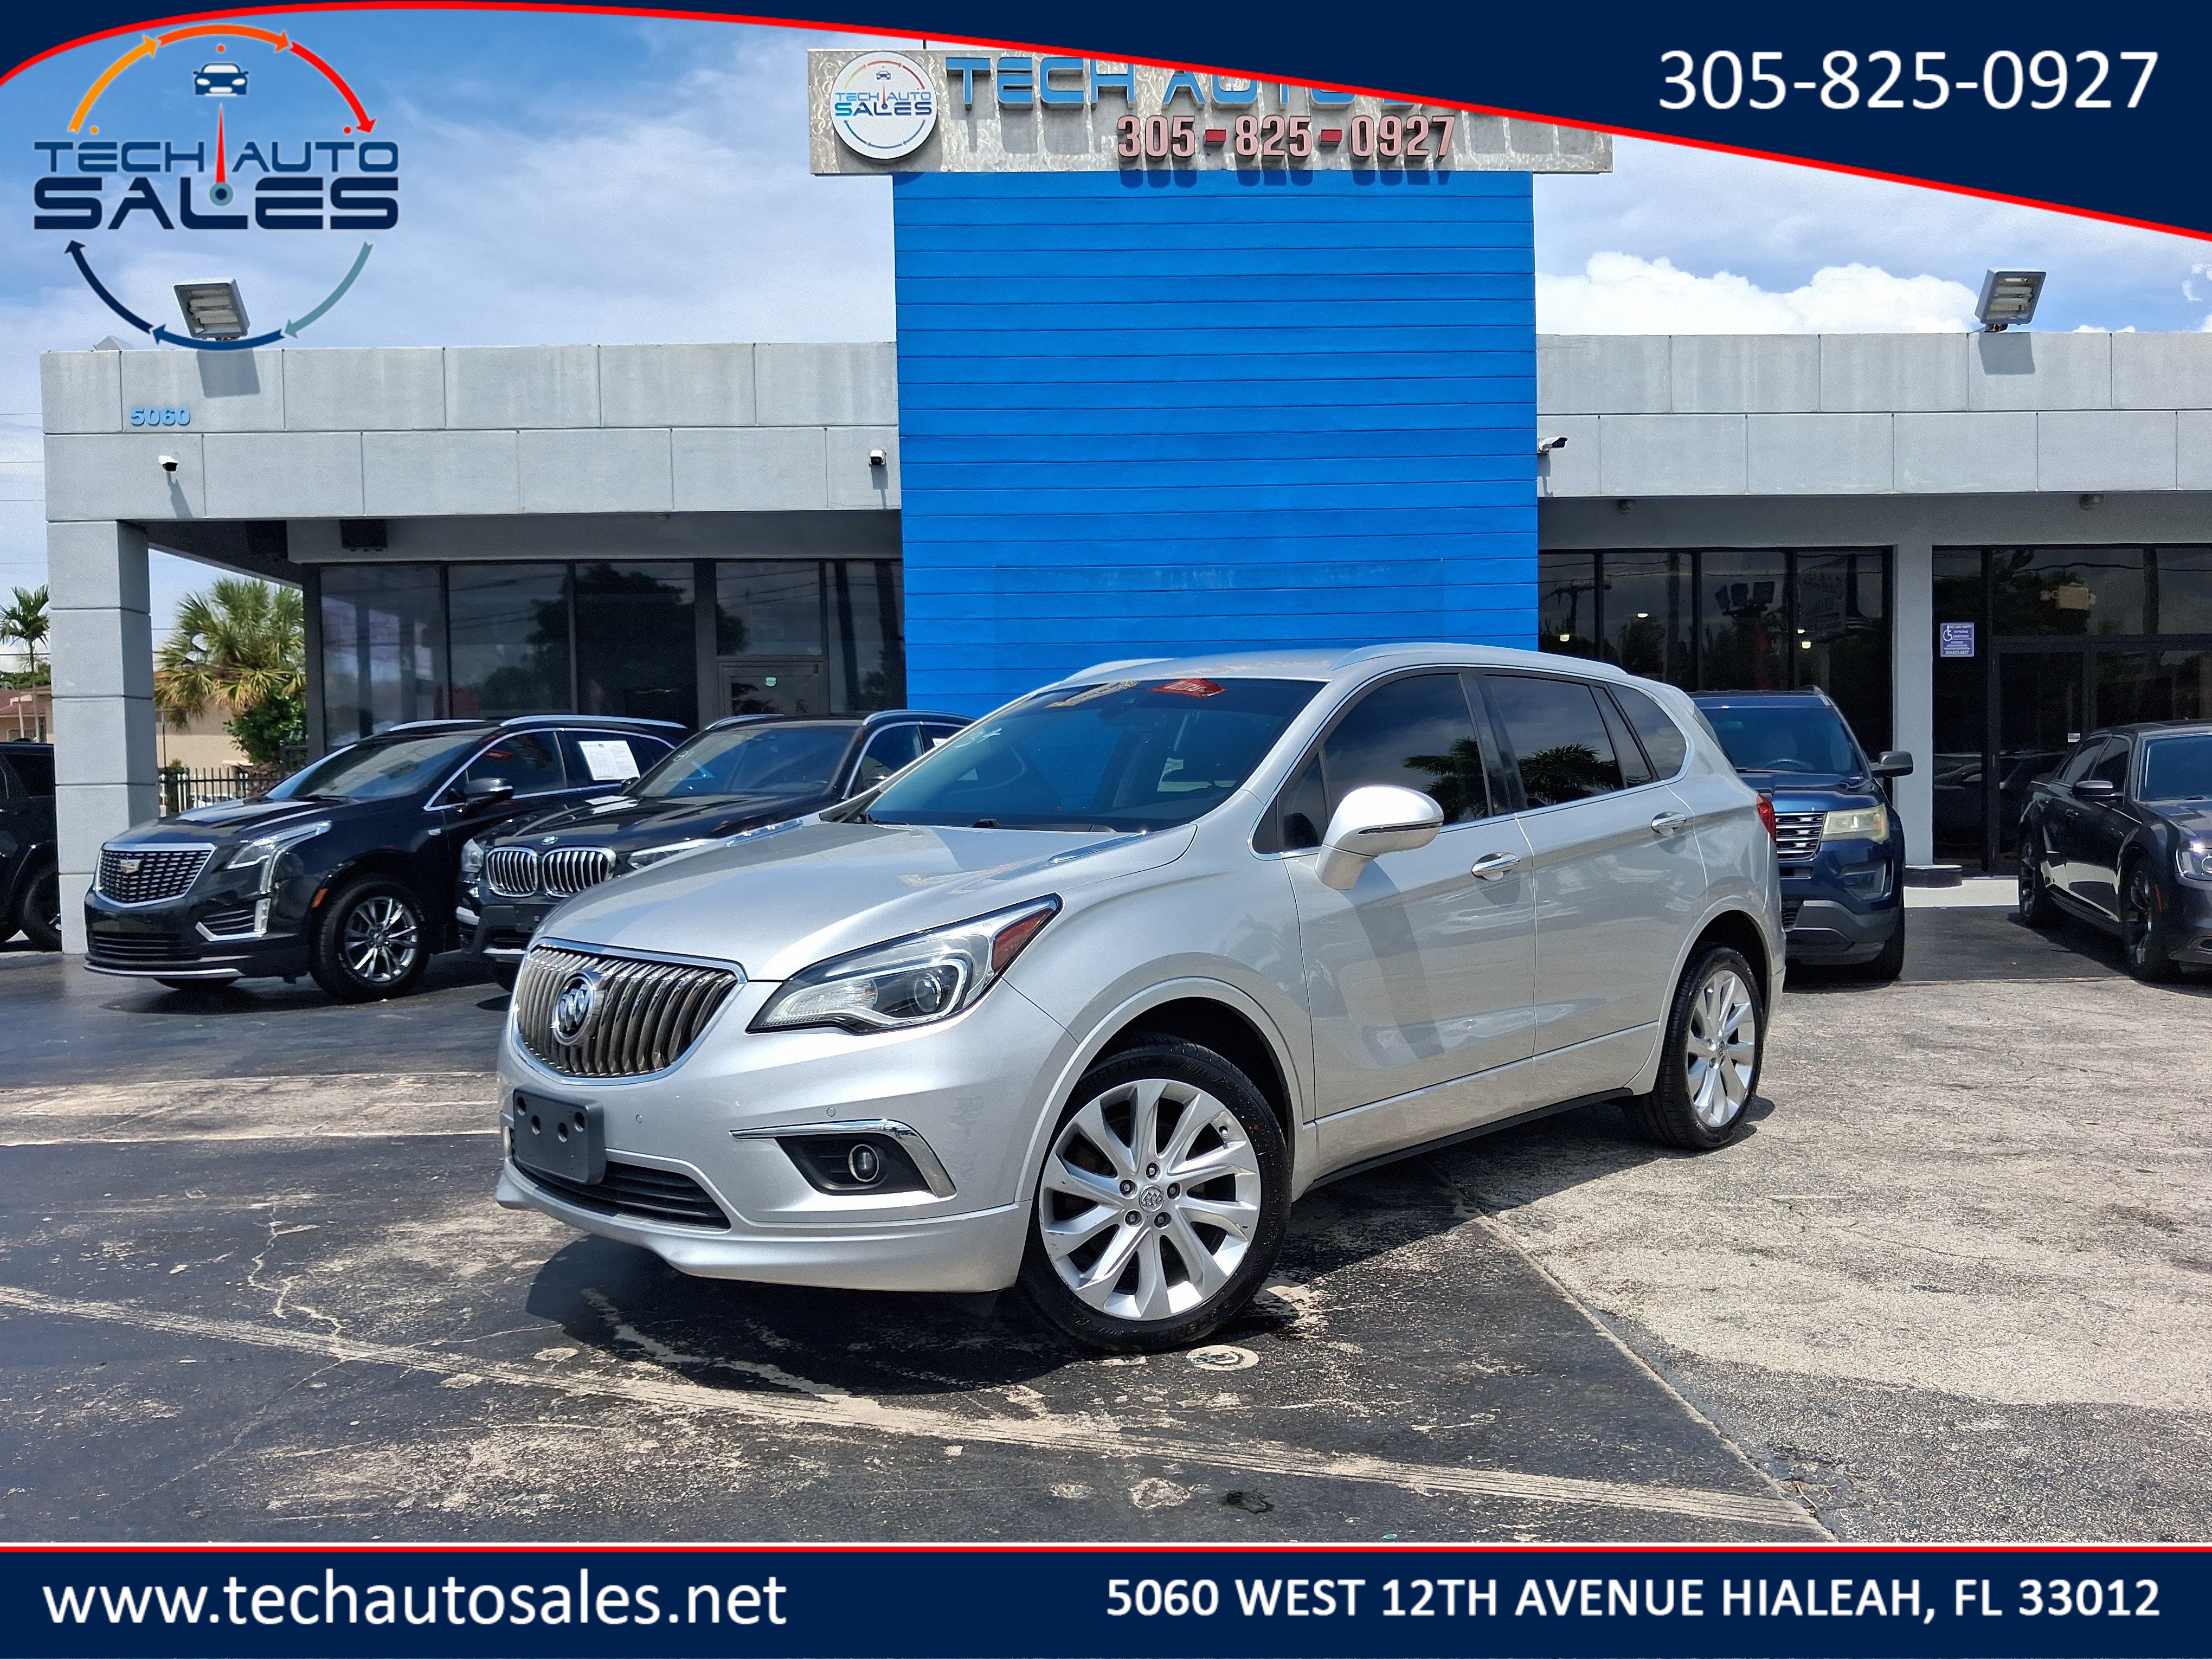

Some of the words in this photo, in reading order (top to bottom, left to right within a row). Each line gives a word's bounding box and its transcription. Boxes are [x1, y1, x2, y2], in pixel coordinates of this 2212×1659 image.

[945, 56, 1136, 105] TECH
[835, 92, 879, 101] TECH
[887, 91, 931, 101] AUTO
[834, 101, 933, 117] SALES
[1117, 114, 1456, 158] 305-825-0927
[130, 407, 191, 426] 5060
